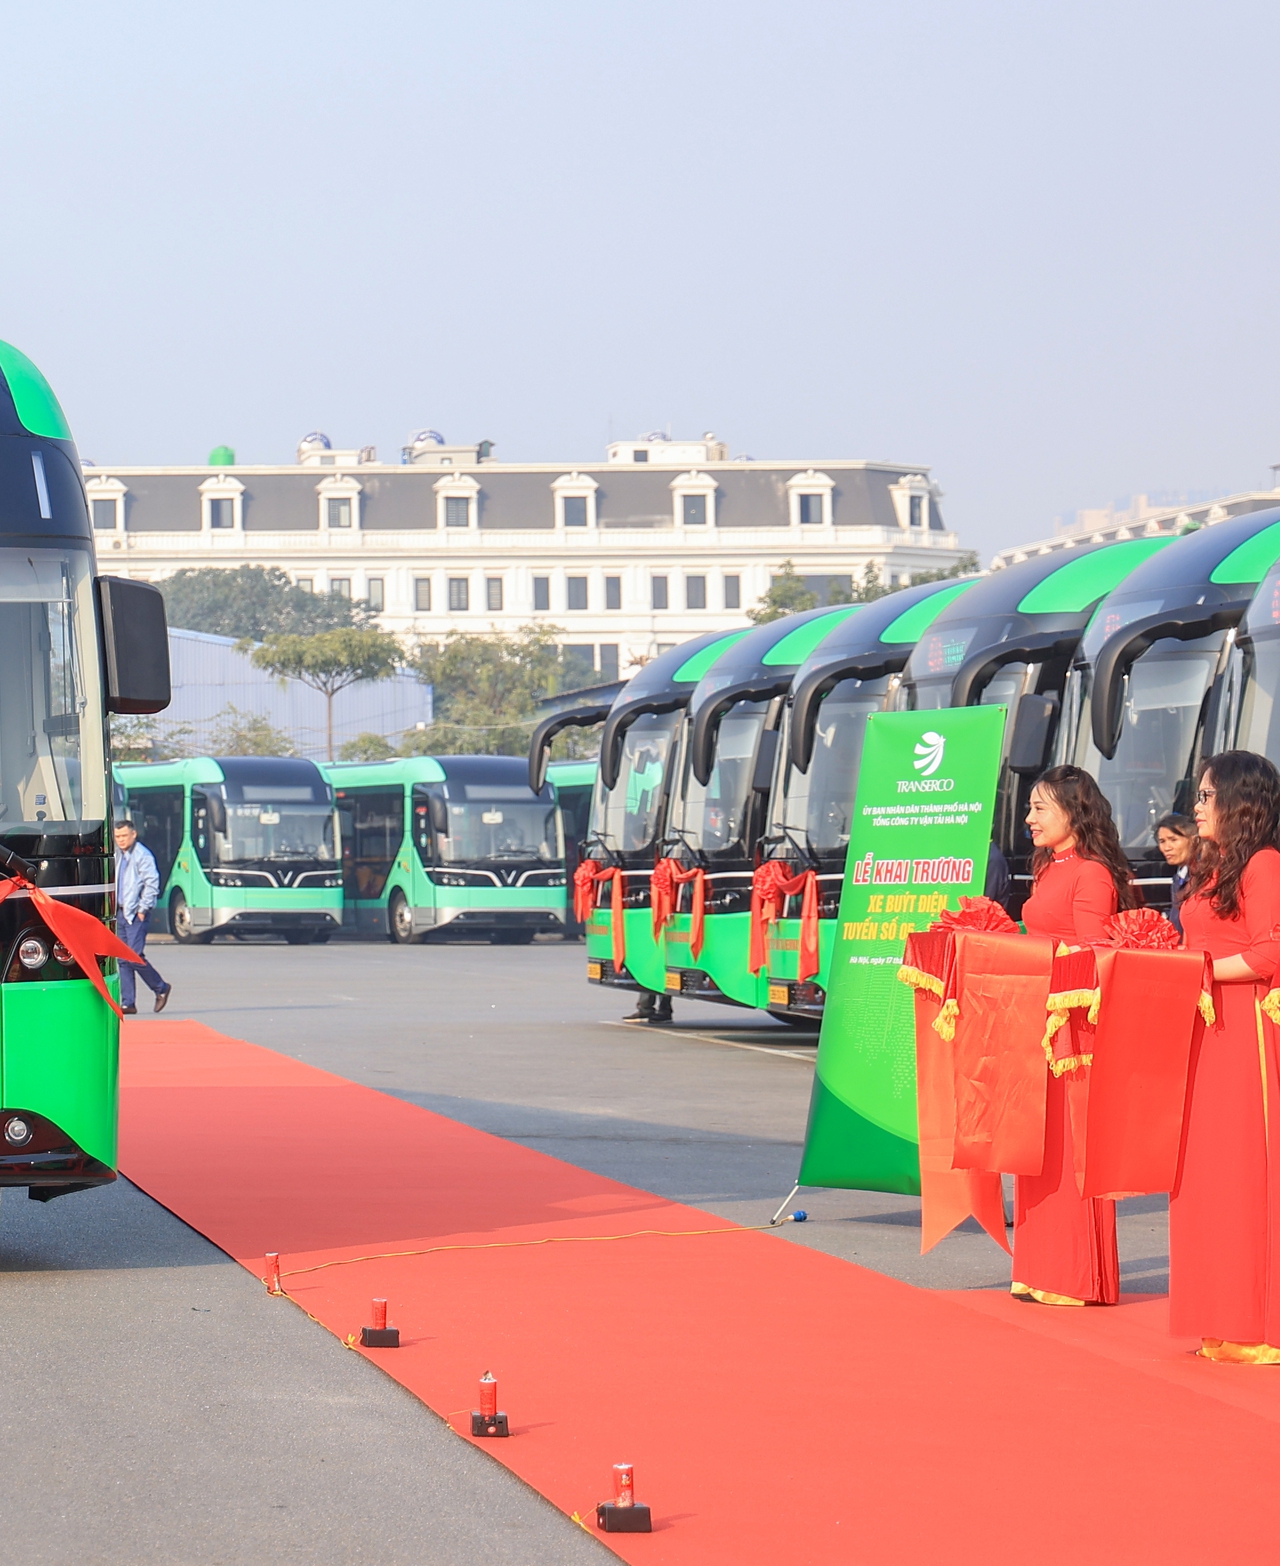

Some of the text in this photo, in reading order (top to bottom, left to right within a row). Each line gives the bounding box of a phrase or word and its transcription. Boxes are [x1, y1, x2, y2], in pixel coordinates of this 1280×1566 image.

[897, 779, 955, 793] TRANSERCO
[863, 802, 982, 816] ỦY BAN NHÂN DÂN THÀNH PHỐ HÀ NỘI
[873, 814, 969, 827] TỔNG CÔNG TY VẬN TẢI HÀ NỘI
[853, 853, 974, 885] LỄ KHAI TRƯƠNG
[868, 891, 948, 917] XE BUÝT ĐIỆN
[843, 916, 879, 940] TUYẾN
[881, 916, 899, 940] SỐ
